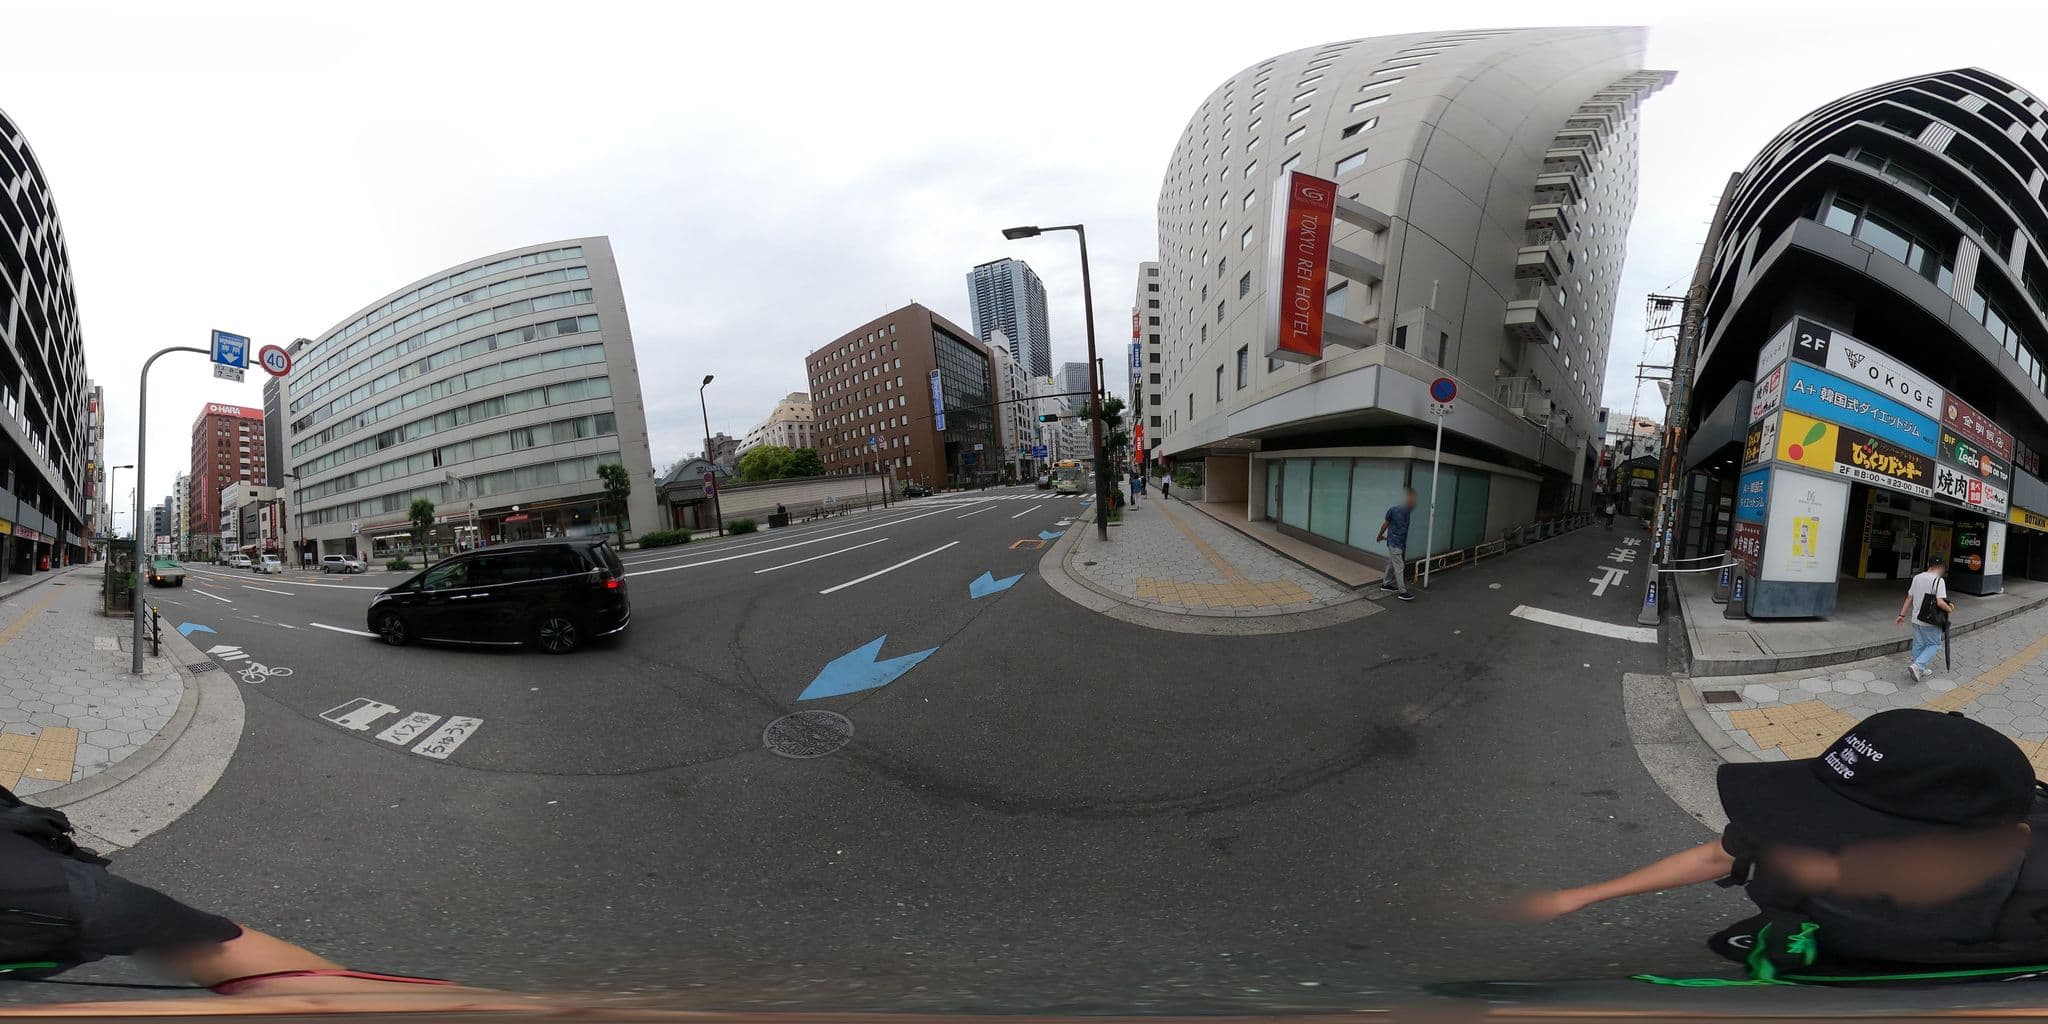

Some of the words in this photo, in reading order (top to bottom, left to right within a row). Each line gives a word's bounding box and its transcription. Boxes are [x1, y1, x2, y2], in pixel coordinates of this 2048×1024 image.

[1299, 214, 1318, 255] TOKYU
[1296, 258, 1313, 281] REI
[1293, 285, 1311, 339] HOTEL
[1800, 333, 1826, 351] 2F
[266, 352, 285, 369] 40
[1868, 366, 1935, 409] OKOGE
[218, 405, 240, 415] HARA
[1793, 379, 1817, 395] A+
[1820, 386, 1920, 437] 韓国式ダイエットジム
[1840, 465, 1850, 475] 2F
[1852, 442, 1922, 480] びっくりドンキー
[1958, 446, 1979, 469] Zeela
[1937, 468, 1967, 500] 焼肉
[391, 714, 432, 742] バス停
[422, 718, 473, 755] ちゅうい
[1840, 748, 1857, 765] the
[1845, 732, 1884, 762] Archive
[1824, 751, 1855, 779] future
